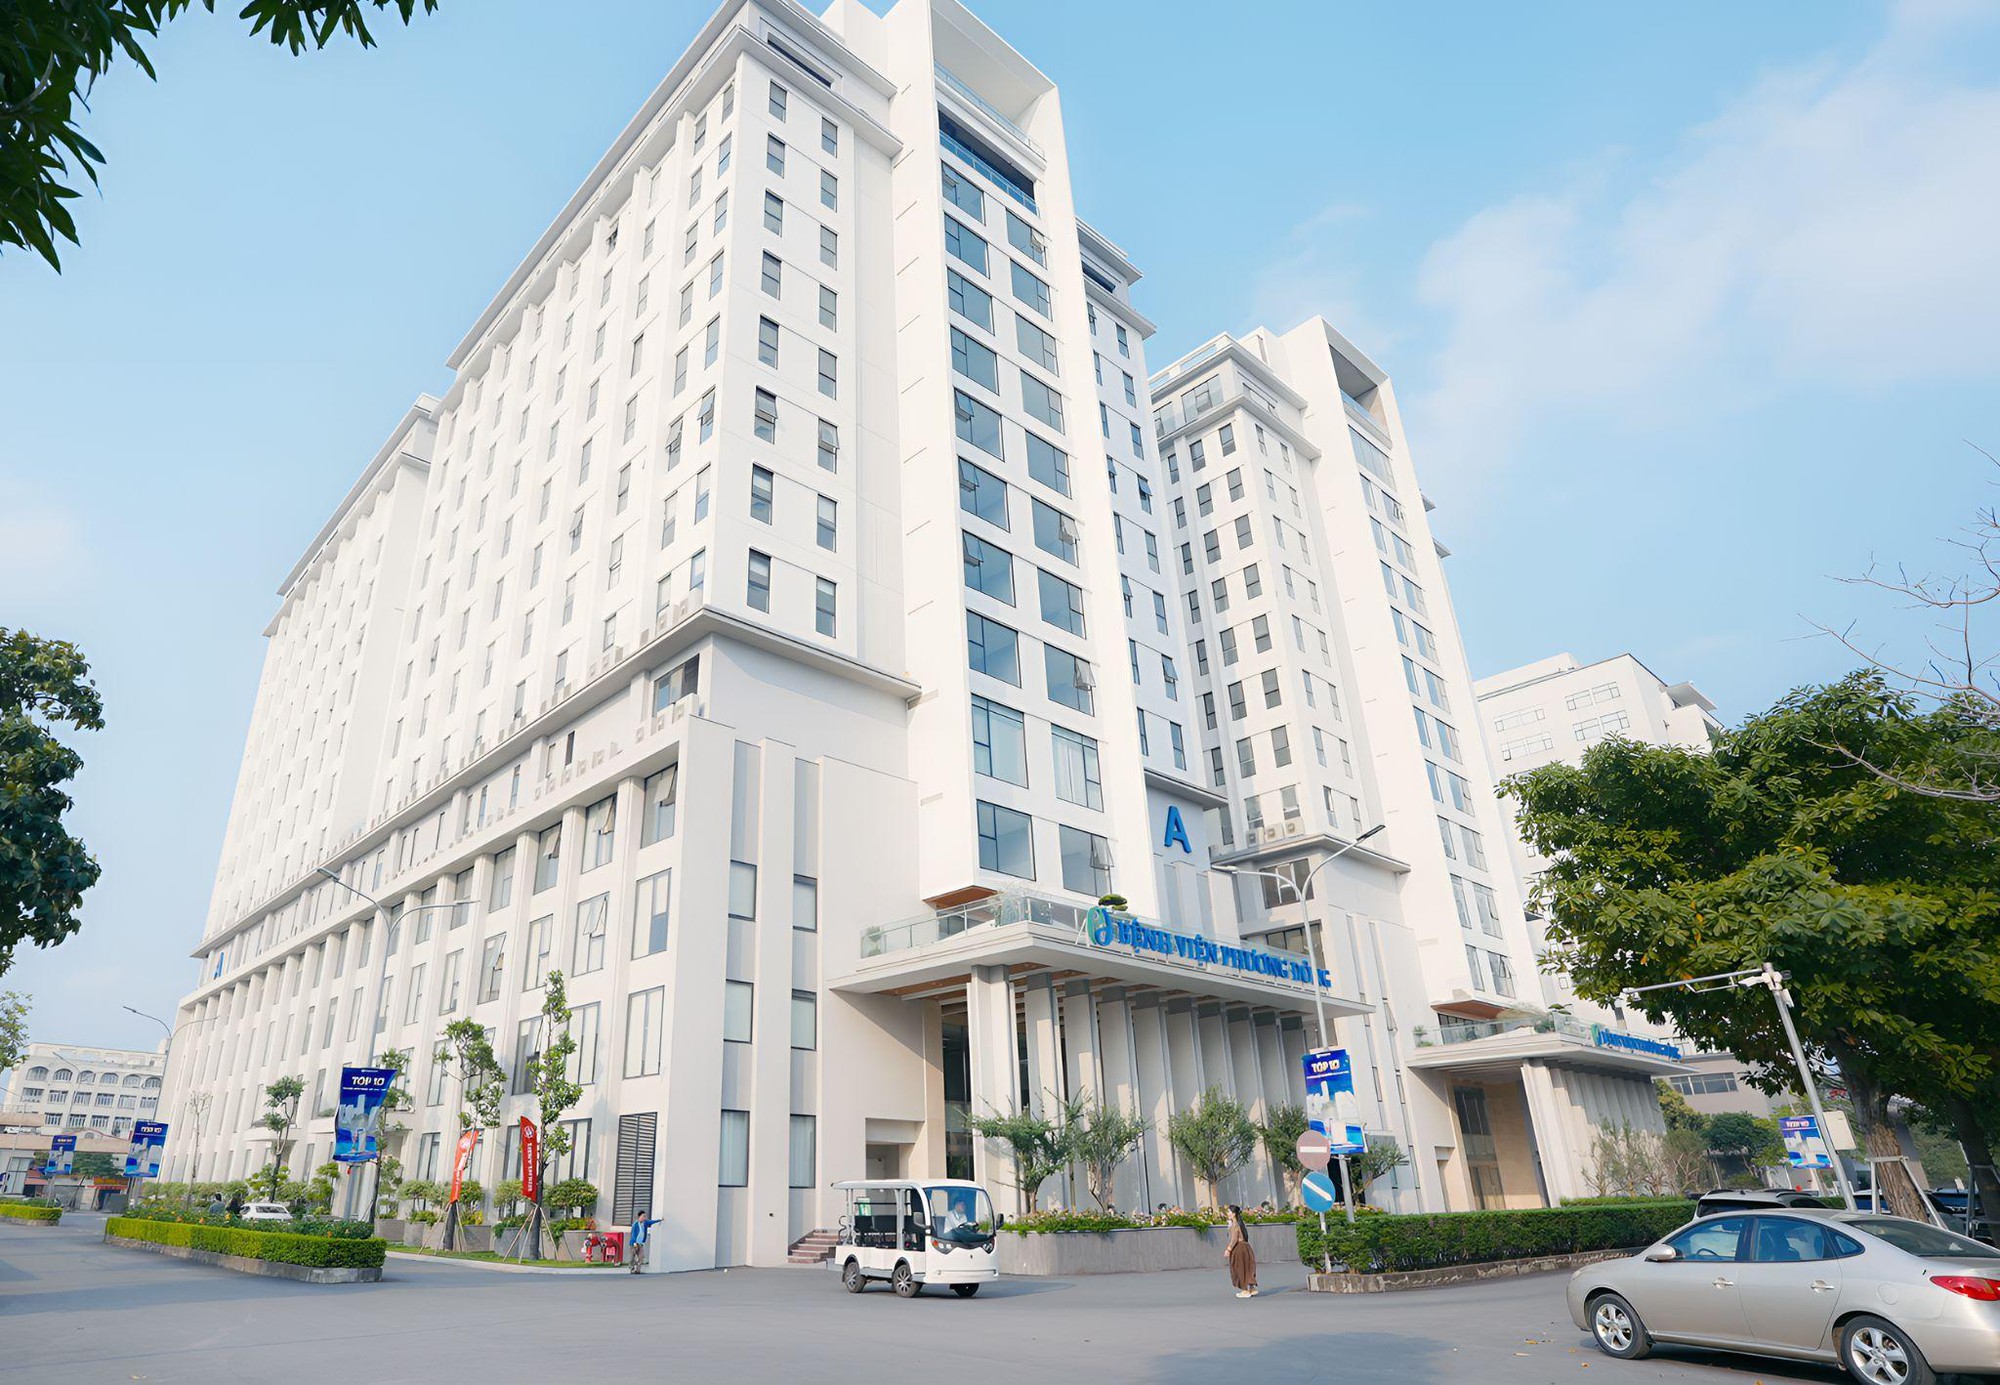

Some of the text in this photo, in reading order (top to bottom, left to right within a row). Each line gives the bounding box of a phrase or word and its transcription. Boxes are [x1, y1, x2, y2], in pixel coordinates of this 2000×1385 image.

[1164, 805, 1192, 854] A
[1117, 918, 1174, 954] BỆNH
[1174, 934, 1218, 966] VIỆN
[352, 1076, 385, 1086] TOP 10
